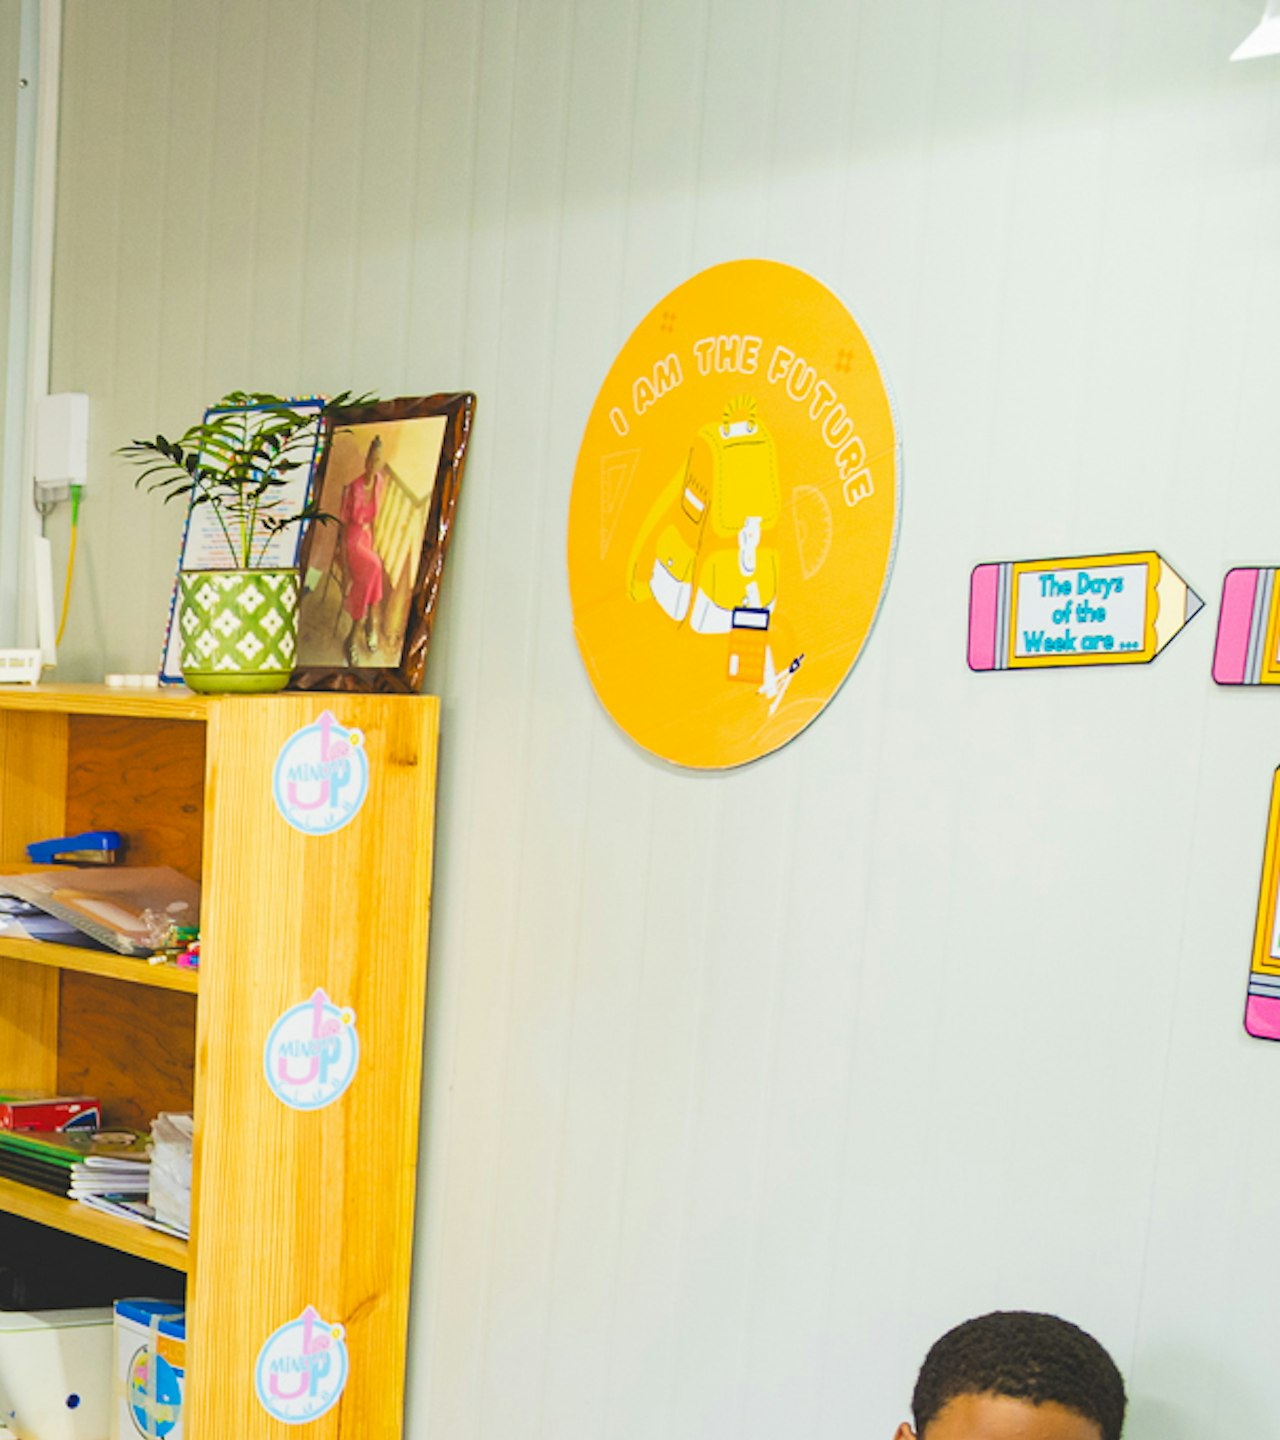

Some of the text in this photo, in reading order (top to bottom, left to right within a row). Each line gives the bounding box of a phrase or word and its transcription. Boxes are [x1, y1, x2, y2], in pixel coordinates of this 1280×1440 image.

[609, 335, 875, 507] I AM THE FUTURE
[1039, 572, 1123, 599] The Days
[1052, 599, 1107, 623] of the
[1023, 628, 1076, 652] Week
[1081, 634, 1114, 650] are
